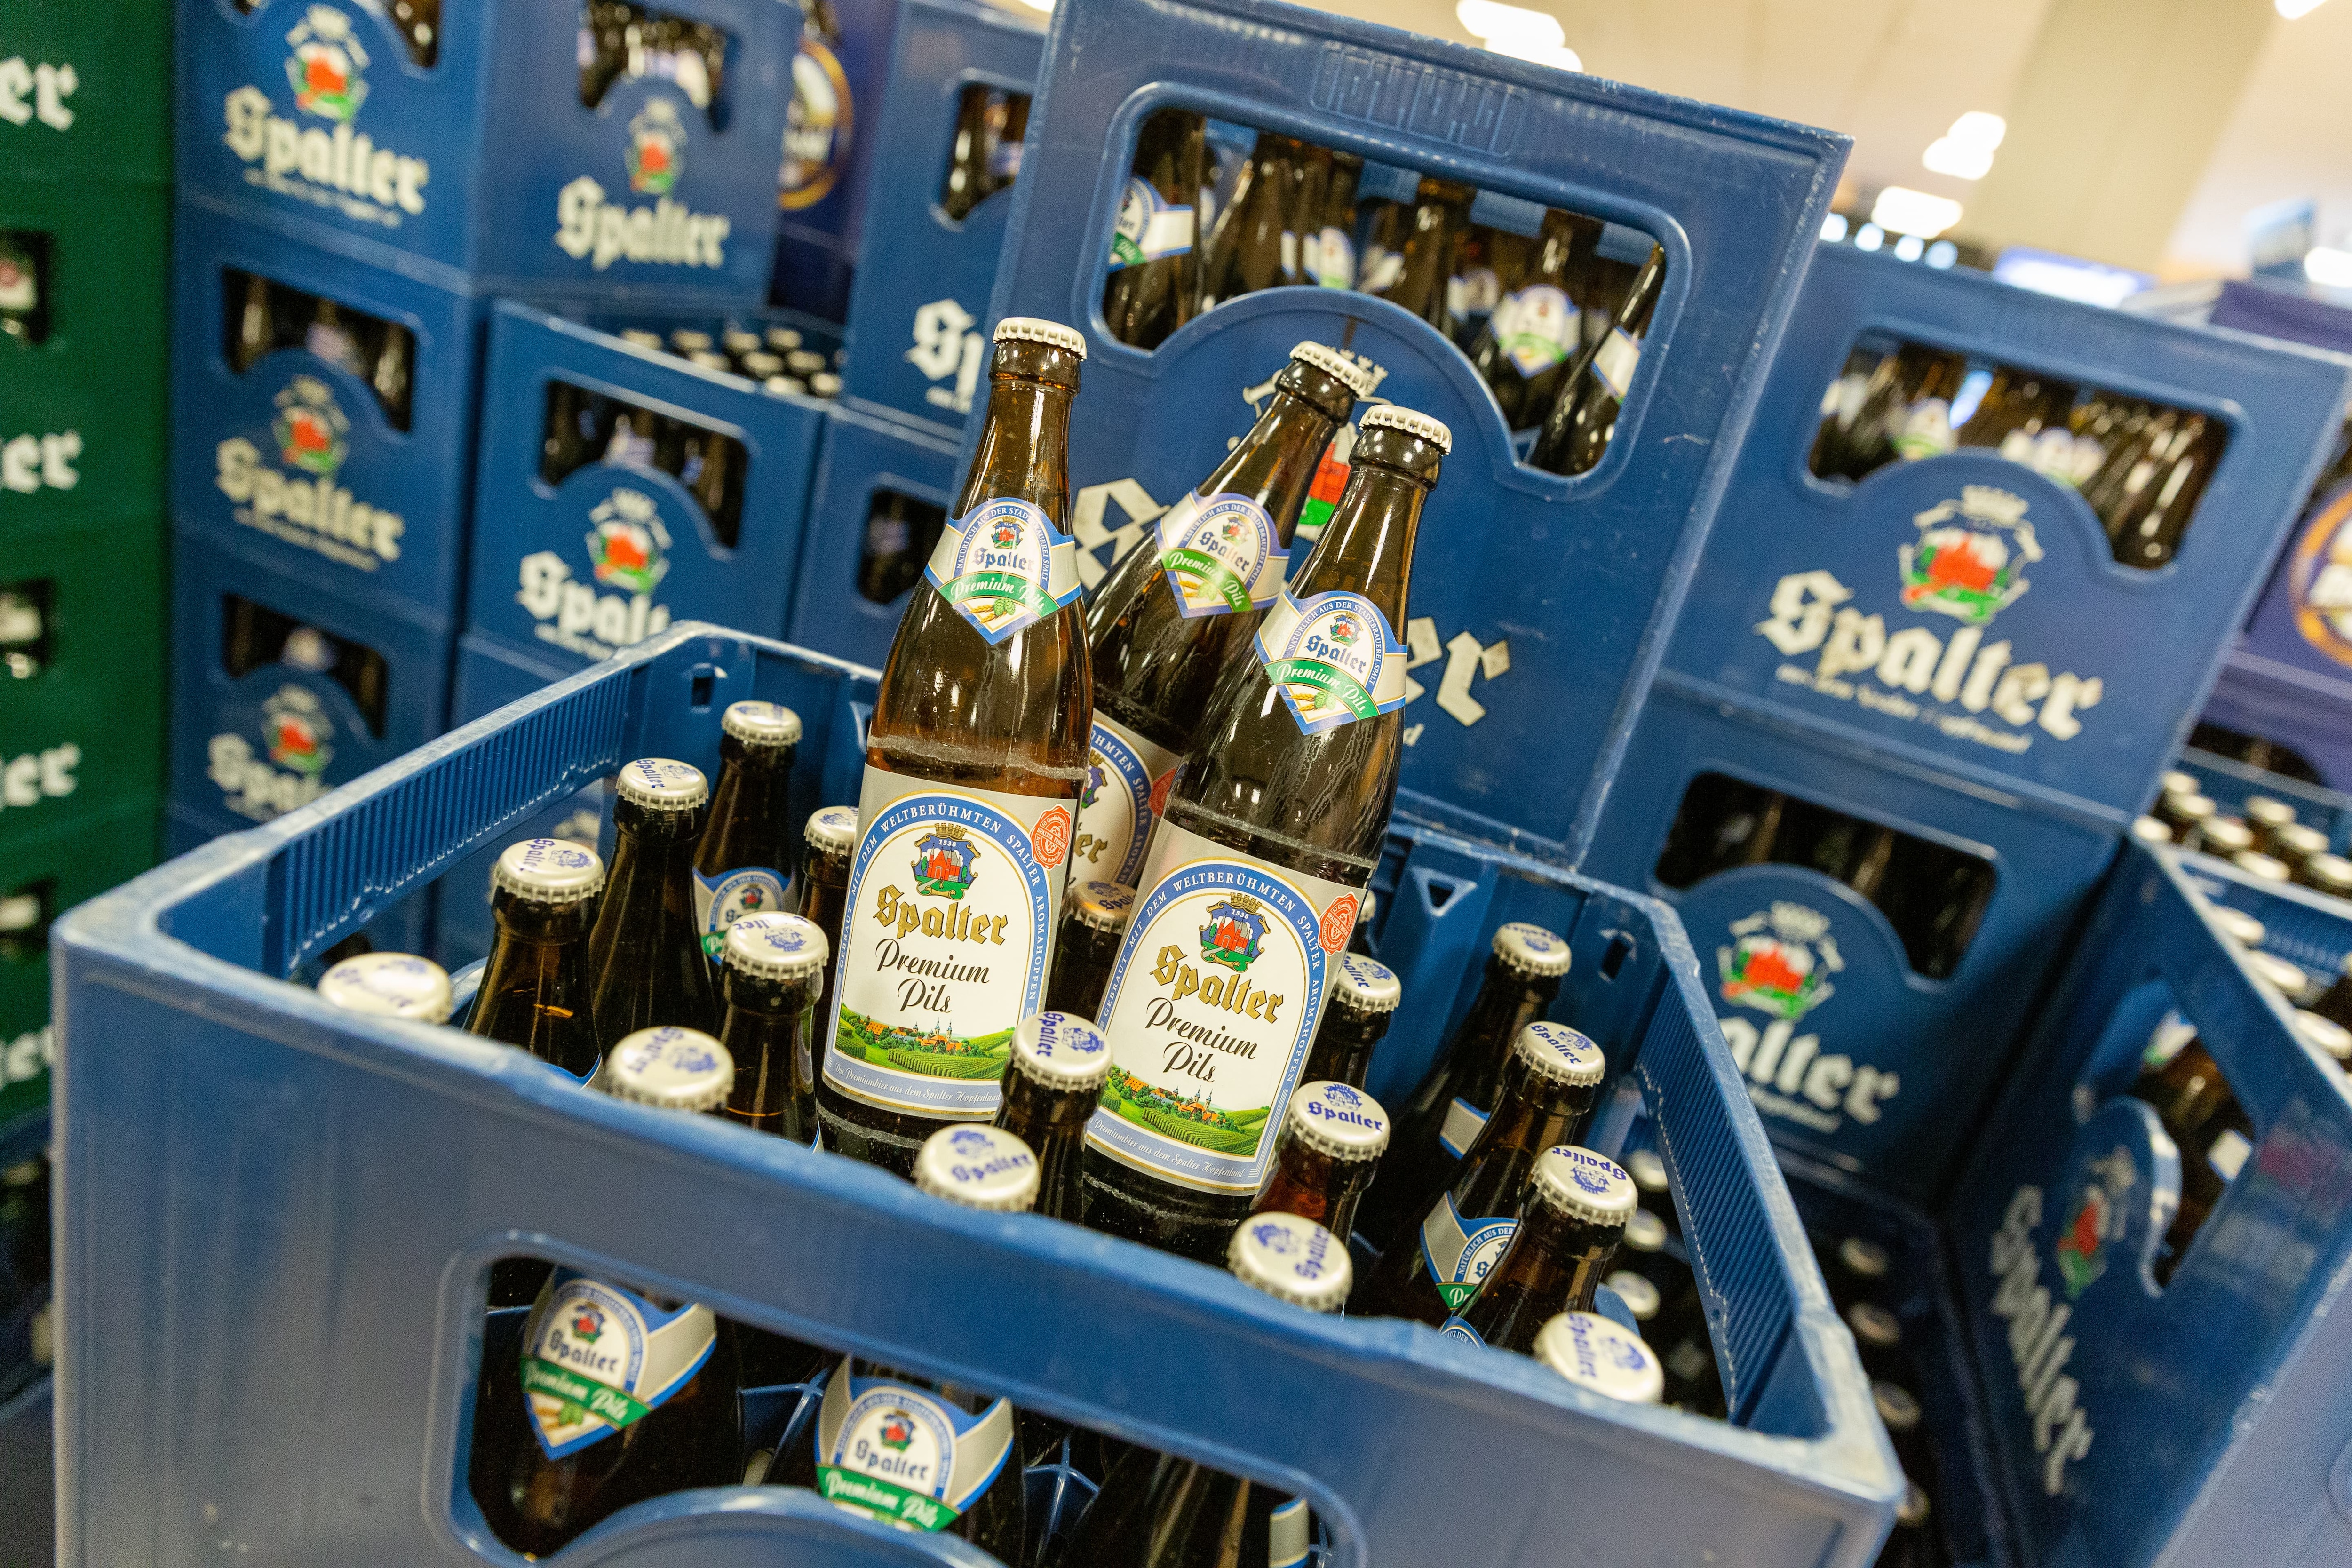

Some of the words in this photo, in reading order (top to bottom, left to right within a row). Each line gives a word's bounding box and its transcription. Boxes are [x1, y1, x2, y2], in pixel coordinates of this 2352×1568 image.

[224, 85, 430, 215] Spalter
[555, 175, 730, 270] Spalter
[214, 437, 405, 562] Spalter
[1231, 504, 1246, 513] DER
[956, 523, 978, 569] NATÜRLICH
[991, 507, 1008, 517] DER
[1041, 559, 1050, 582] SPALT
[973, 547, 1034, 572] Spalter
[1198, 531, 1250, 572] Spalter
[950, 577, 1015, 600] Premium
[1019, 584, 1045, 612] Pils
[1169, 552, 1221, 579] Premiu
[1223, 580, 1245, 608] Pils
[1288, 612, 1318, 651] NATÜRLICH
[1319, 603, 1334, 613] AUS
[1335, 601, 1352, 610] DER
[1353, 604, 1382, 662] STADTBRAUEREI
[1368, 663, 1381, 686] SPALT
[1303, 635, 1367, 674] Spalter
[1754, 570, 2104, 740] Spalter
[1276, 663, 1341, 690] Premium
[1340, 683, 1367, 714] Pils
[636, 759, 666, 789] Spalter
[938, 838, 957, 848] 1538
[1036, 827, 1054, 841] SPALTER
[839, 905, 853, 969] GEBRAUT
[851, 868, 861, 897] MIT
[861, 835, 878, 863] DEM
[880, 802, 1003, 834] WELTBERÜHMTEN
[1006, 834, 1041, 887] SPALTER
[1028, 895, 1045, 1001] AROMAHOPFEN
[873, 884, 1009, 946] Spalter
[1146, 893, 1168, 918] DEM
[1172, 872, 1296, 914] WELTBERÜHMTEN
[1231, 908, 1250, 920] 1538
[1128, 921, 1143, 949] MIT
[1296, 915, 1320, 971] SPALTER
[875, 938, 991, 984] Premium
[1149, 944, 1284, 1024] Spalter
[1343, 955, 1370, 987] palter
[897, 978, 953, 1014] Pils
[1102, 955, 1128, 1017] GEBRAUT
[1037, 1011, 1065, 1057] Spalter
[1146, 997, 1258, 1059] Premium
[1286, 979, 1319, 1082] AROMAHOPFEN
[1531, 1025, 1581, 1064] Spalter
[1163, 1040, 1217, 1083] Pils
[1720, 1013, 1902, 1127] alter
[845, 1068, 889, 1092] Premiumbier
[889, 1084, 904, 1095] aus
[905, 1086, 922, 1098] dem
[922, 1088, 954, 1102] Spalter
[955, 1090, 1001, 1103] Hopfenland
[1308, 1101, 1383, 1132] Spalter
[1093, 1117, 1139, 1150] Premiumbier
[1138, 1143, 1153, 1155] aus
[1153, 1146, 1171, 1162] dem
[1171, 1153, 1201, 1171] Spalter
[1202, 1160, 1246, 1179] Hopfenland
[1552, 1147, 1627, 1181] Spalter
[1458, 1236, 1483, 1275] NATÜRLICH
[1483, 1229, 1497, 1239] AUS
